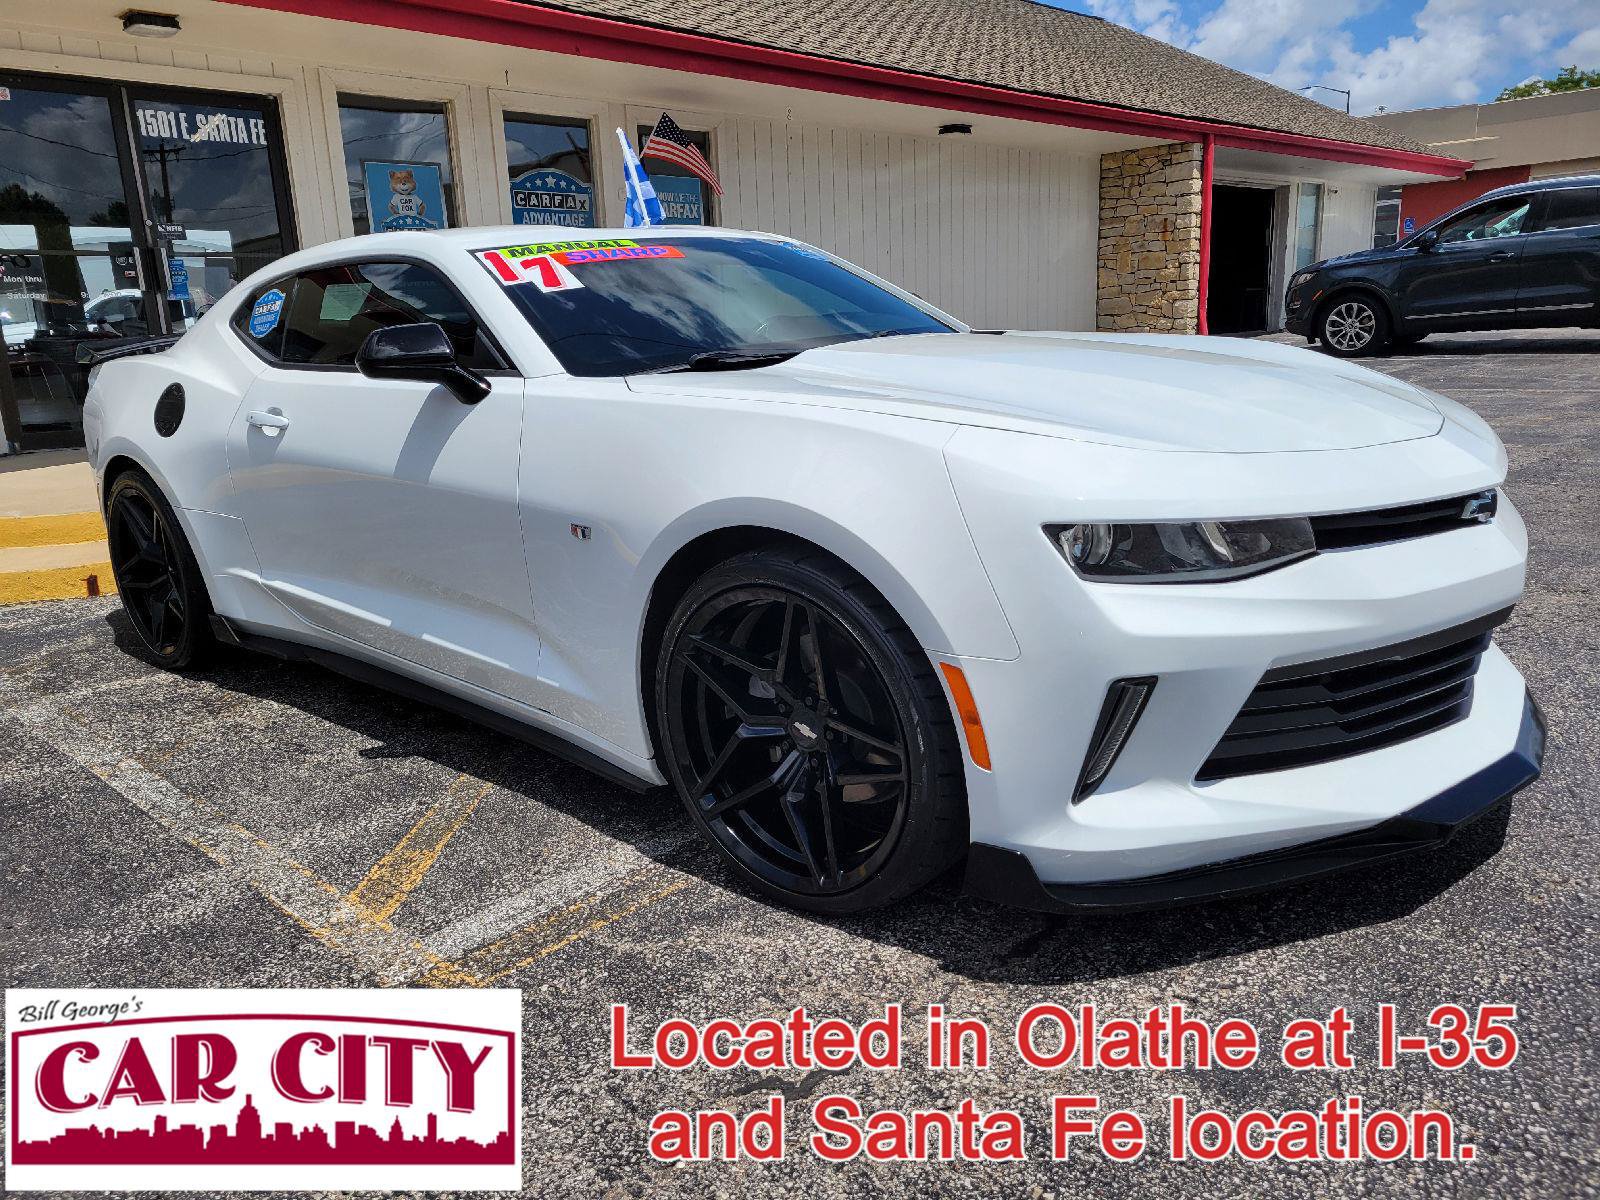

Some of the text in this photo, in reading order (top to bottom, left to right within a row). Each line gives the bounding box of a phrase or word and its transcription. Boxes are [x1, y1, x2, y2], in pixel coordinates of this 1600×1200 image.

[136, 108, 178, 139] 1501
[196, 113, 249, 143] SANTA
[249, 118, 268, 145] FE
[516, 193, 588, 210] CARFAX
[656, 192, 674, 202] HOW
[663, 202, 700, 219] ARFAX
[522, 211, 586, 227] ADVANTAGE
[507, 240, 630, 257] MANUAL
[565, 247, 667, 262] SHARP
[484, 251, 564, 288] 17
[3, 275, 42, 283] Mon thru
[7, 292, 46, 301] Saturday
